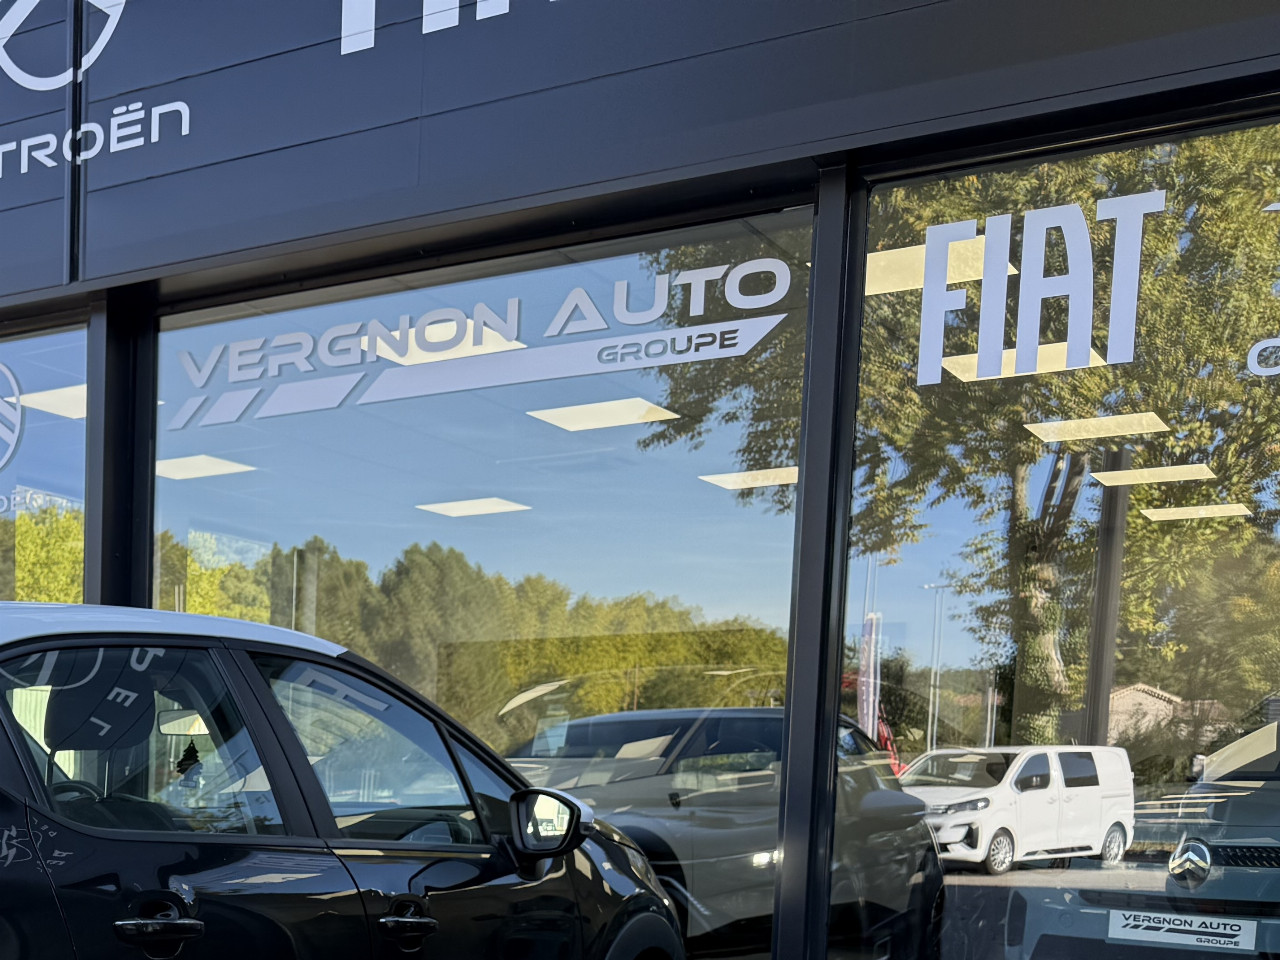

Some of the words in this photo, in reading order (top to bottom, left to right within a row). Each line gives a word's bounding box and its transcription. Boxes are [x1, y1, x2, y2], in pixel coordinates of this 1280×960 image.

[916, 189, 1167, 386] FIAT
[178, 297, 519, 388] VERGNON
[542, 257, 792, 338] AUTO
[596, 328, 740, 364] GROUPE
[1121, 913, 1194, 928] VERGNON
[1197, 920, 1242, 932] AUTO
[1195, 937, 1240, 947] GROUPE
